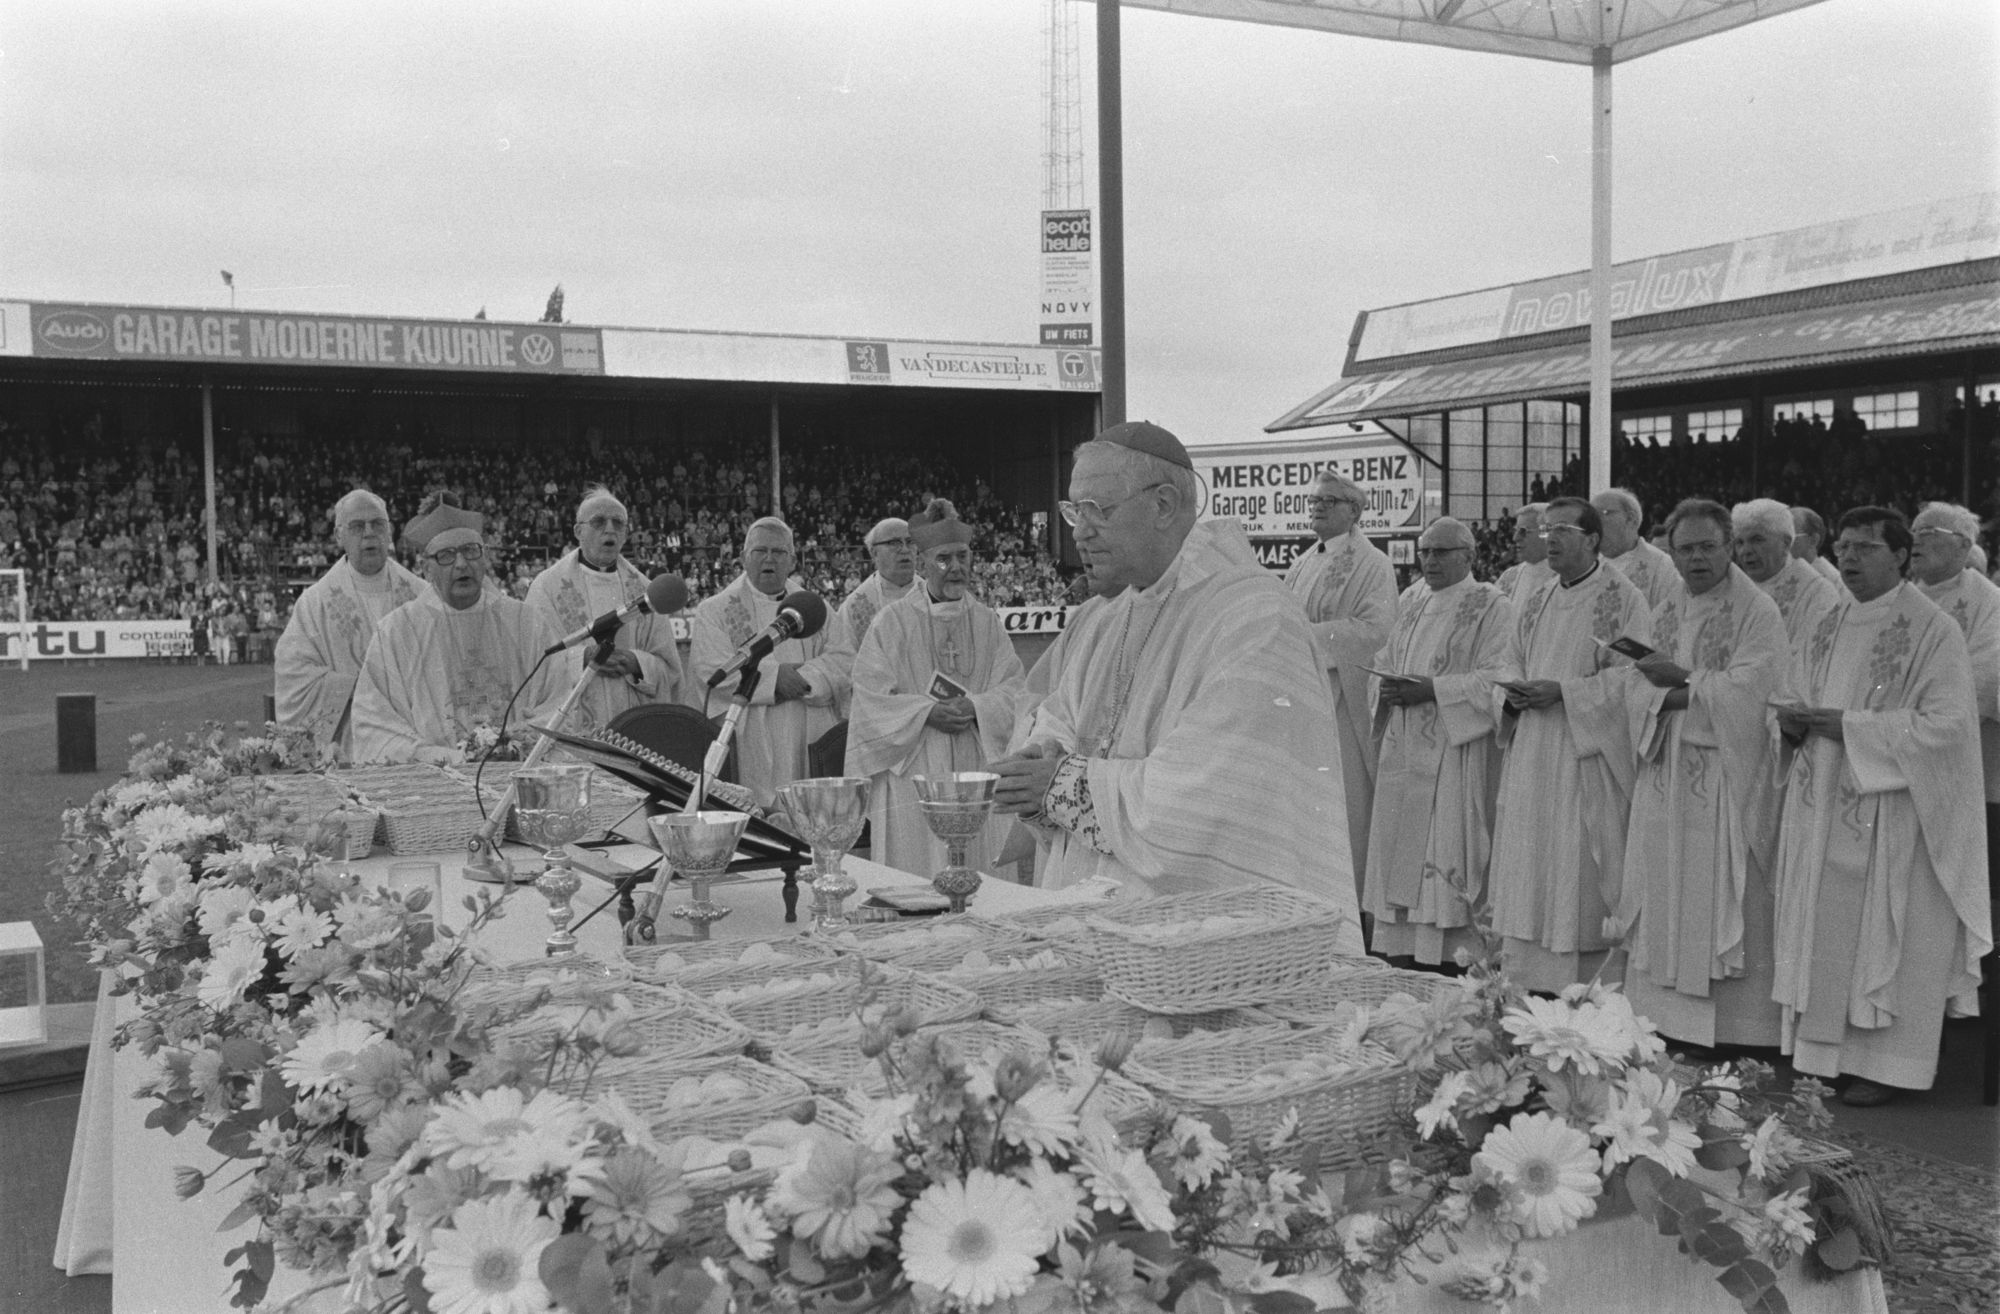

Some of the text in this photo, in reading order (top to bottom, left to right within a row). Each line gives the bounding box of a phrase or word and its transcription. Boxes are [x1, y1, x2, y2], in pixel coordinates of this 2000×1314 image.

[1043, 234, 1090, 251] heule
[1042, 302, 1091, 313] NOVY
[44, 319, 103, 338] Audi
[1064, 329, 1089, 340] FIETS
[113, 313, 517, 367] GARAGE MODERNE KUURNE
[900, 358, 1048, 376] VANDECASTEELE
[1212, 493, 1267, 520] Garage
[1359, 519, 1390, 529] SCRON
